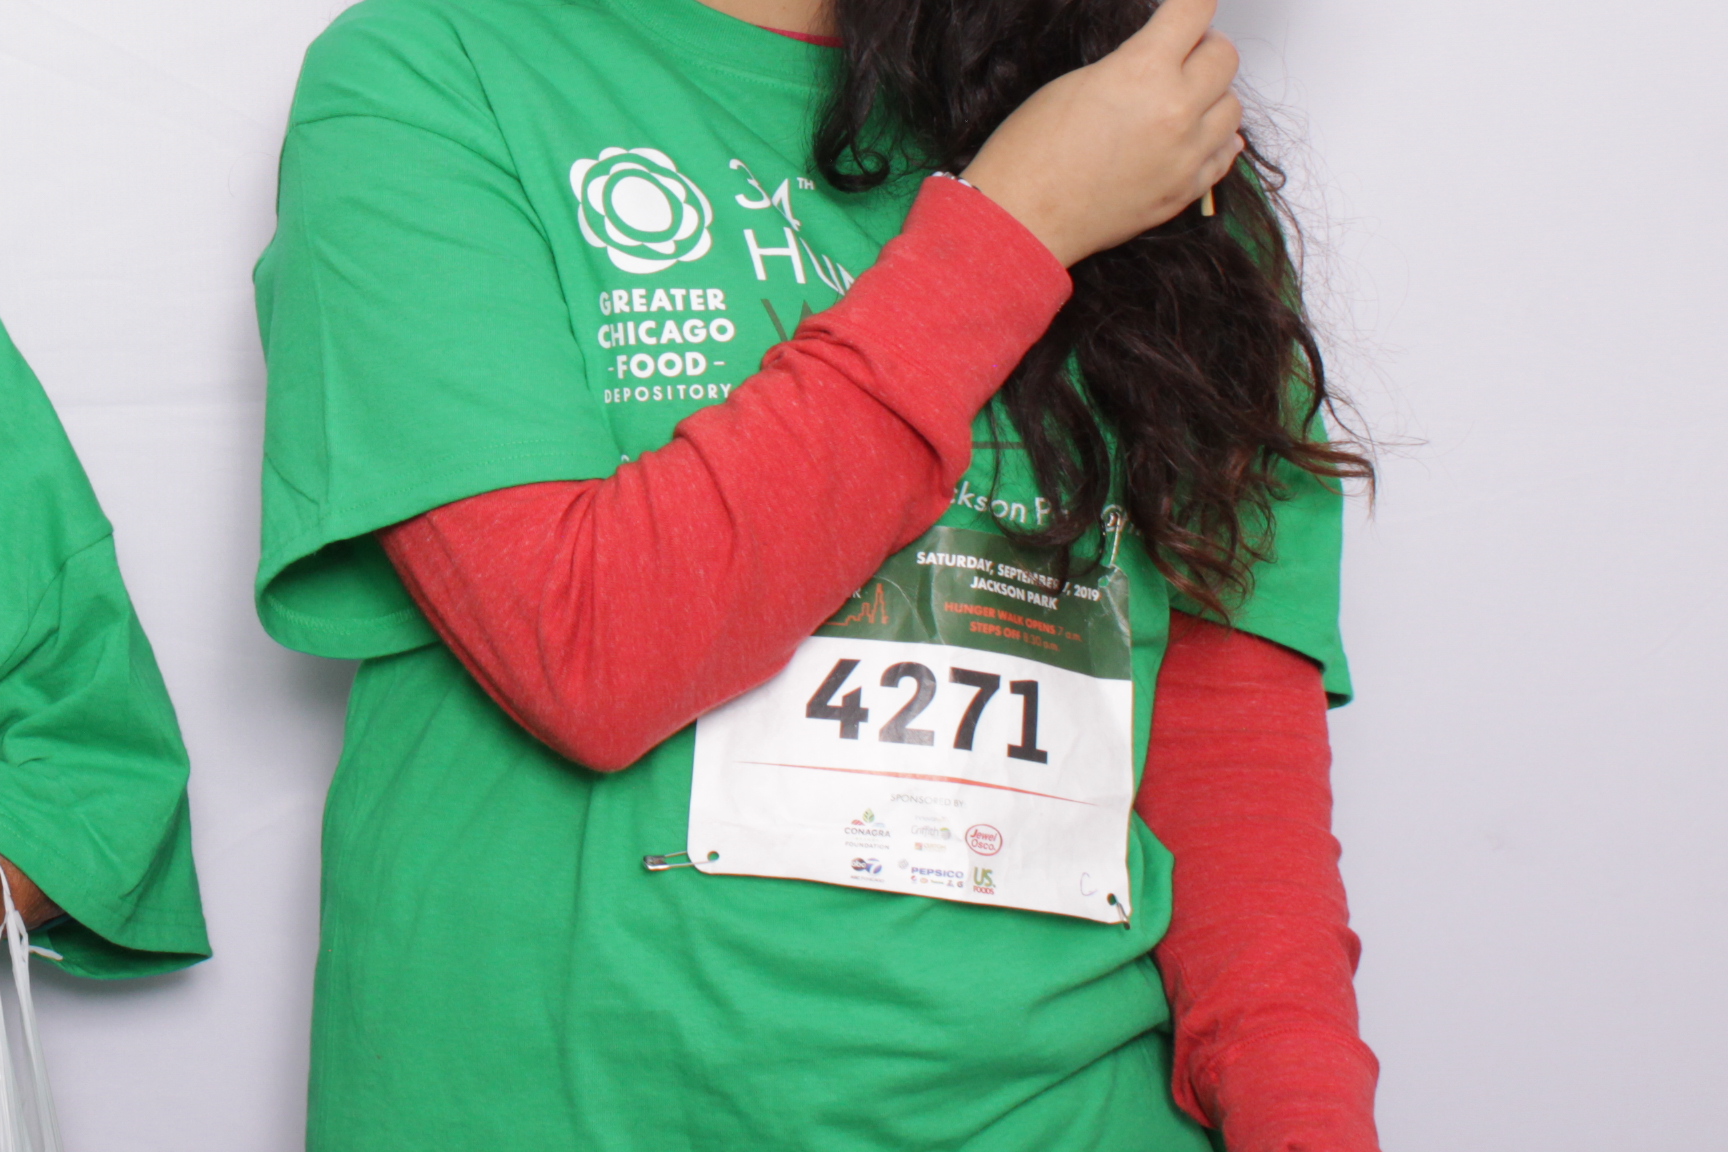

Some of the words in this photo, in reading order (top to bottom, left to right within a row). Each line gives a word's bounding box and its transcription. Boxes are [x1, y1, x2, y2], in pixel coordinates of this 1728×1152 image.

[599, 288, 726, 316] GREATER
[598, 318, 736, 348] CHICAGO
[604, 383, 732, 404] DEPOSITORY
[916, 551, 994, 575] SATURDAY,
[1073, 584, 1101, 602] 2019
[970, 576, 1025, 601] JACKSON
[1027, 591, 1058, 610] PARK
[944, 601, 996, 618] HUNGER
[997, 609, 1025, 626] WALK
[1025, 618, 1056, 635] OPENS
[969, 621, 1002, 636] STEPS
[805, 658, 1048, 765] 4271
[890, 794, 952, 807] SPONSORED
[844, 827, 891, 838] CONAGRA
[970, 829, 997, 841] Jewel
[845, 840, 890, 850] FOUNDATION
[911, 866, 964, 879] PEPSICO
